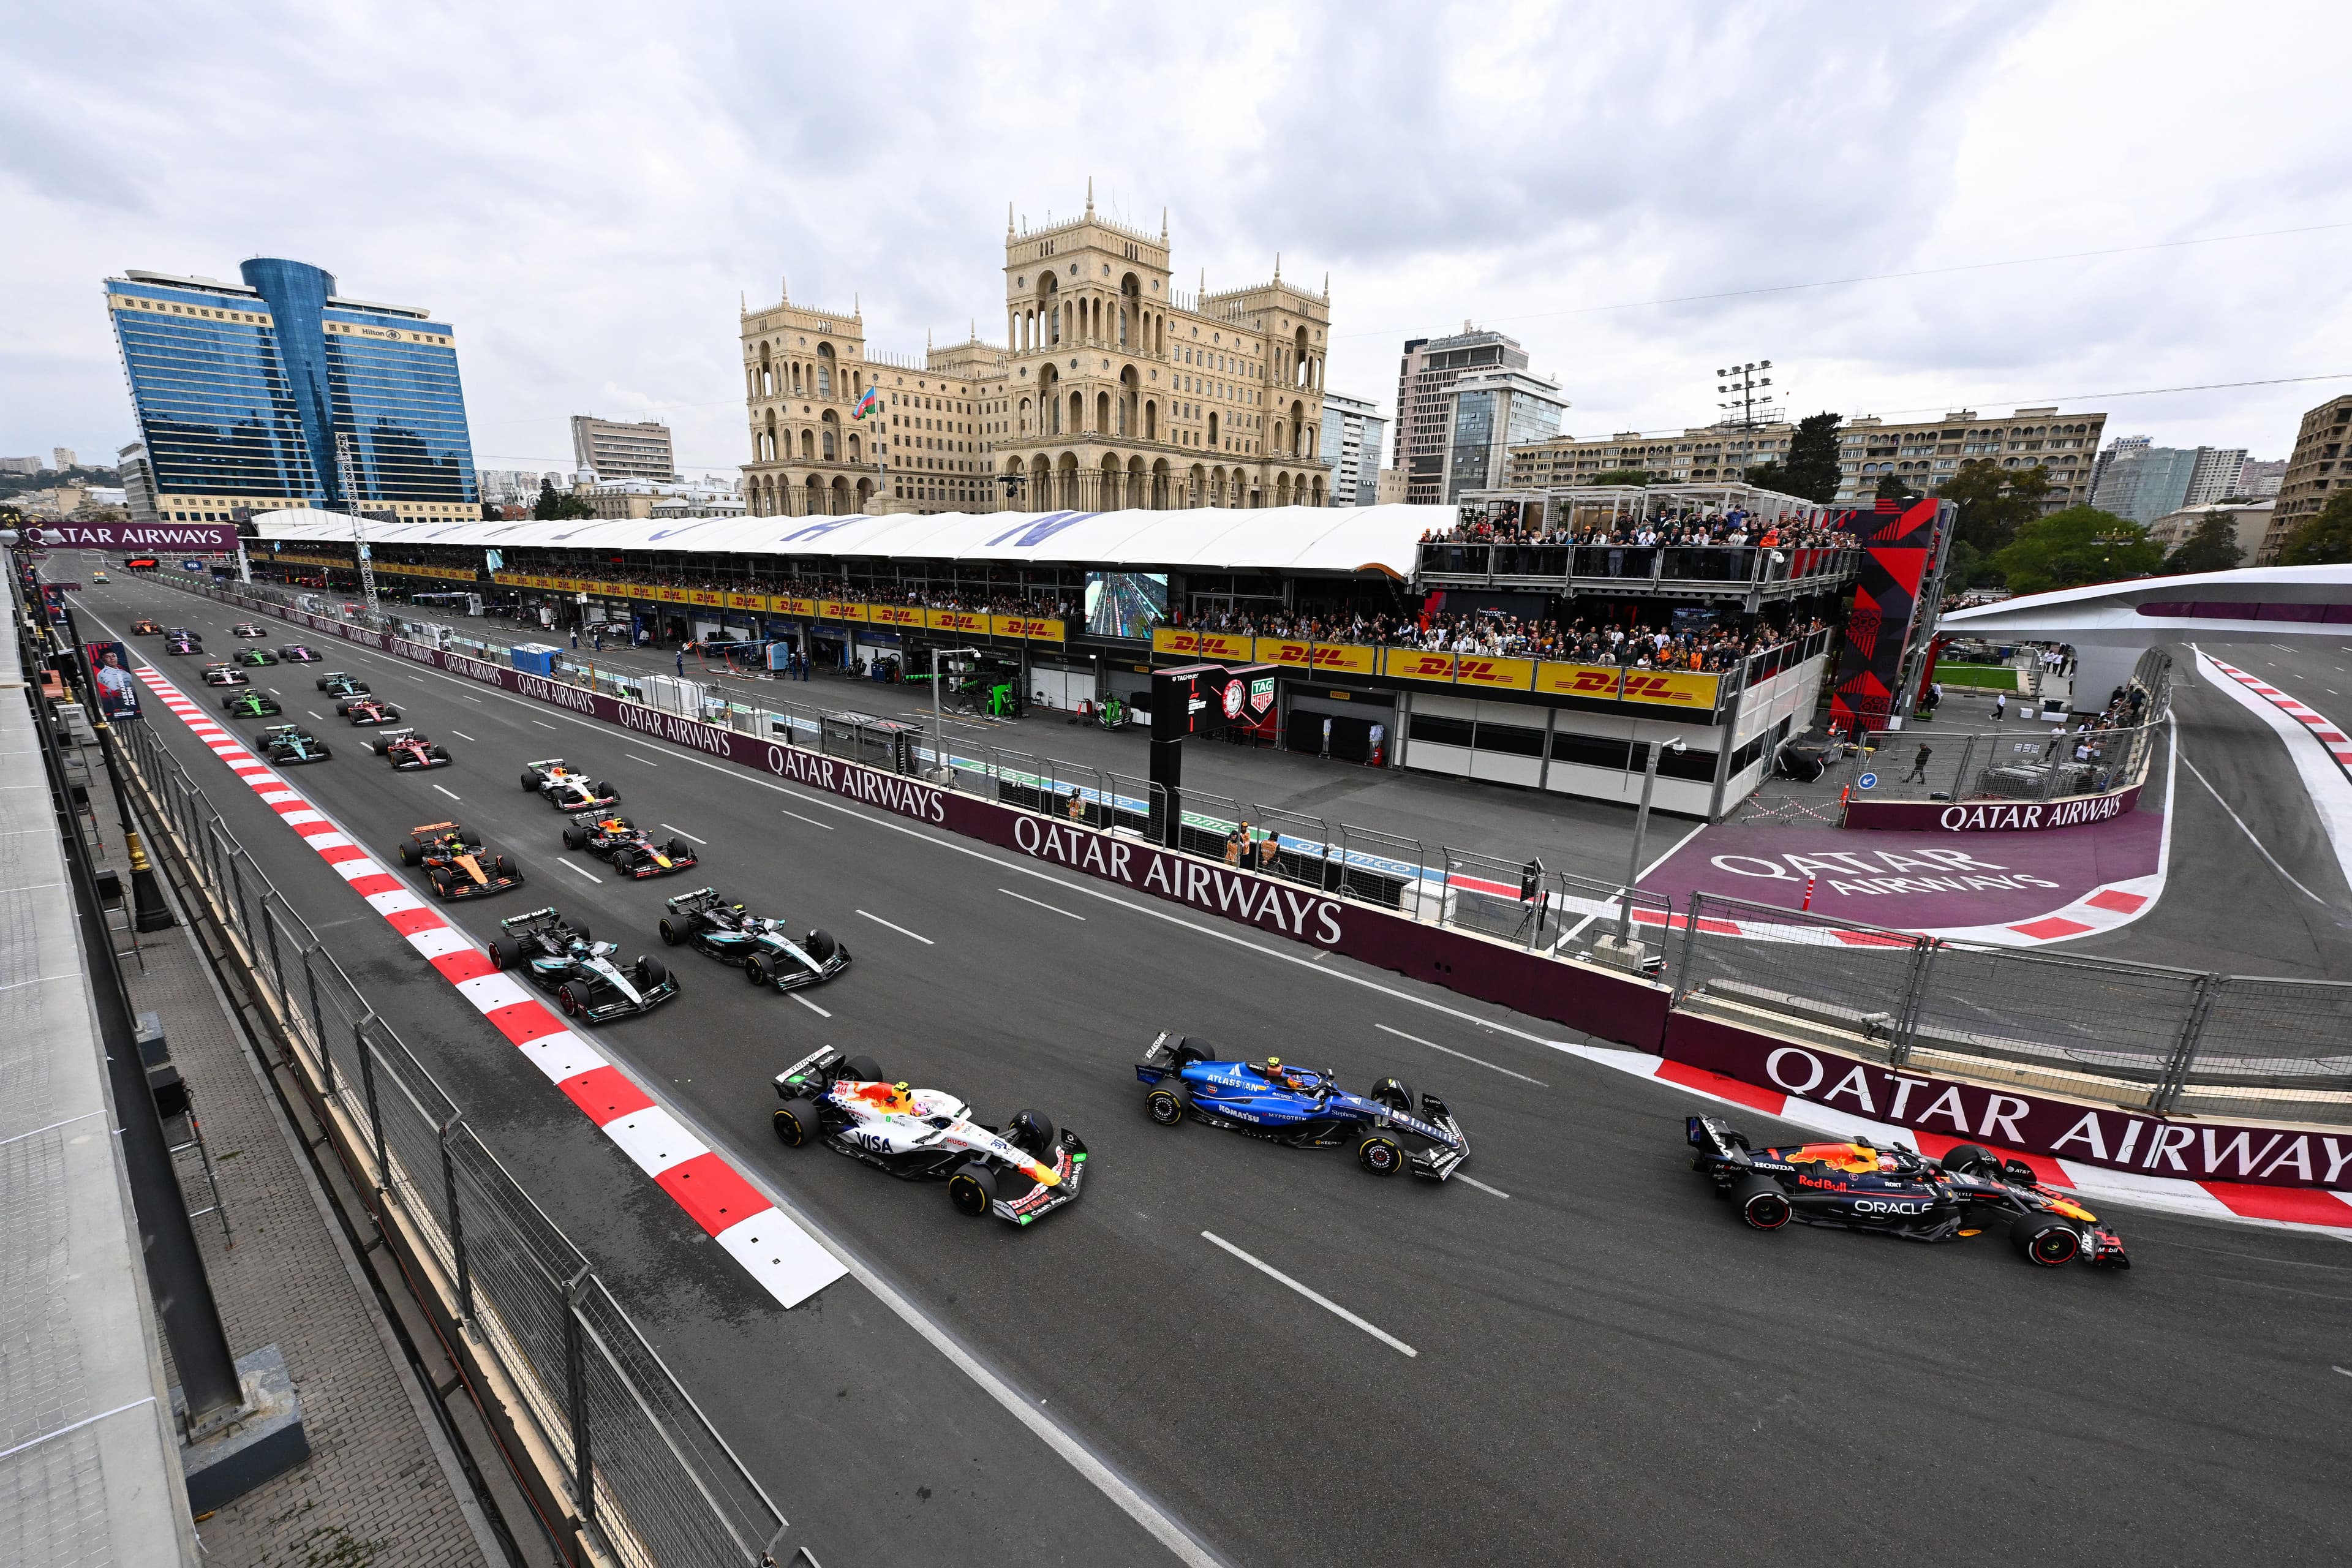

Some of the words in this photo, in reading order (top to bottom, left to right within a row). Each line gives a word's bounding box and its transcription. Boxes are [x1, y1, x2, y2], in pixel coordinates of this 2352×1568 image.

[362, 328, 384, 336] Hilton
[122, 529, 222, 544] AIRWAYS
[606, 586, 620, 594] DHL
[633, 587, 650, 596] DHL
[663, 590, 680, 600] DHL
[696, 594, 716, 603] DHL
[735, 597, 758, 608] DHL
[780, 600, 805, 612] DHL
[829, 605, 857, 617] DHL
[881, 609, 913, 623] DHL
[940, 615, 976, 629] DHL
[1008, 620, 1048, 637] DHL
[347, 627, 362, 641] QATAR
[363, 631, 382, 648] AIRWAYS
[1174, 635, 1228, 655] DHL
[390, 639, 408, 656] QATAR
[409, 644, 434, 665] AIRWAYS
[1280, 645, 1344, 666] DHL
[444, 655, 469, 676] QATAR
[470, 662, 501, 686] AIRWAYS
[1417, 657, 1497, 681] DHL
[1254, 681, 1272, 692] TAG
[1570, 671, 1673, 698] DHL
[127, 687, 136, 706] ALBON
[518, 675, 550, 700] QATAR
[551, 685, 595, 714] AIRWAYS
[1253, 693, 1272, 710] HEUER
[618, 703, 663, 736] QATAR
[666, 717, 731, 756] AIRWAYS
[768, 745, 836, 790] QATAR
[842, 766, 944, 822] AIRWAYS
[1941, 805, 2043, 831] QATAR
[2046, 794, 2123, 827] AIRWAYS
[590, 839, 609, 848] ORACLE
[1711, 849, 2010, 881] QATAR
[1014, 816, 1132, 882] QATAR
[1144, 854, 1341, 944] AIRWAYS
[1827, 874, 2059, 895] AIRWAYS
[674, 888, 707, 902] PETRONAS
[508, 908, 548, 923] PETRONAS
[1145, 1031, 1167, 1060] ATLASSIAN
[791, 1054, 817, 1072] TUDOR
[820, 1055, 834, 1066] App
[834, 1081, 848, 1096] 30
[1207, 1074, 1258, 1091] ATLASSIAN
[1766, 1047, 2030, 1143] QATAR
[845, 1108, 864, 1118] HONDA
[1218, 1104, 1259, 1123] KOMATSU
[1268, 1112, 1306, 1121] MYPROTEIN
[1332, 1109, 1357, 1118] Stephens
[856, 1131, 894, 1153] VISA
[947, 1137, 968, 1147] HUGO
[990, 1139, 1005, 1150] 30
[1412, 1158, 1430, 1166] betway
[1754, 1161, 1795, 1172] HONDA
[1799, 1175, 1822, 1188] Red
[1823, 1178, 1847, 1192] Bull
[1012, 1187, 1041, 1208] HUGO
[1031, 1205, 1051, 1215] Cash
[1052, 1196, 1067, 1205] App
[1032, 1193, 1050, 1207] Bull
[1855, 1200, 1934, 1215] ORACLE
